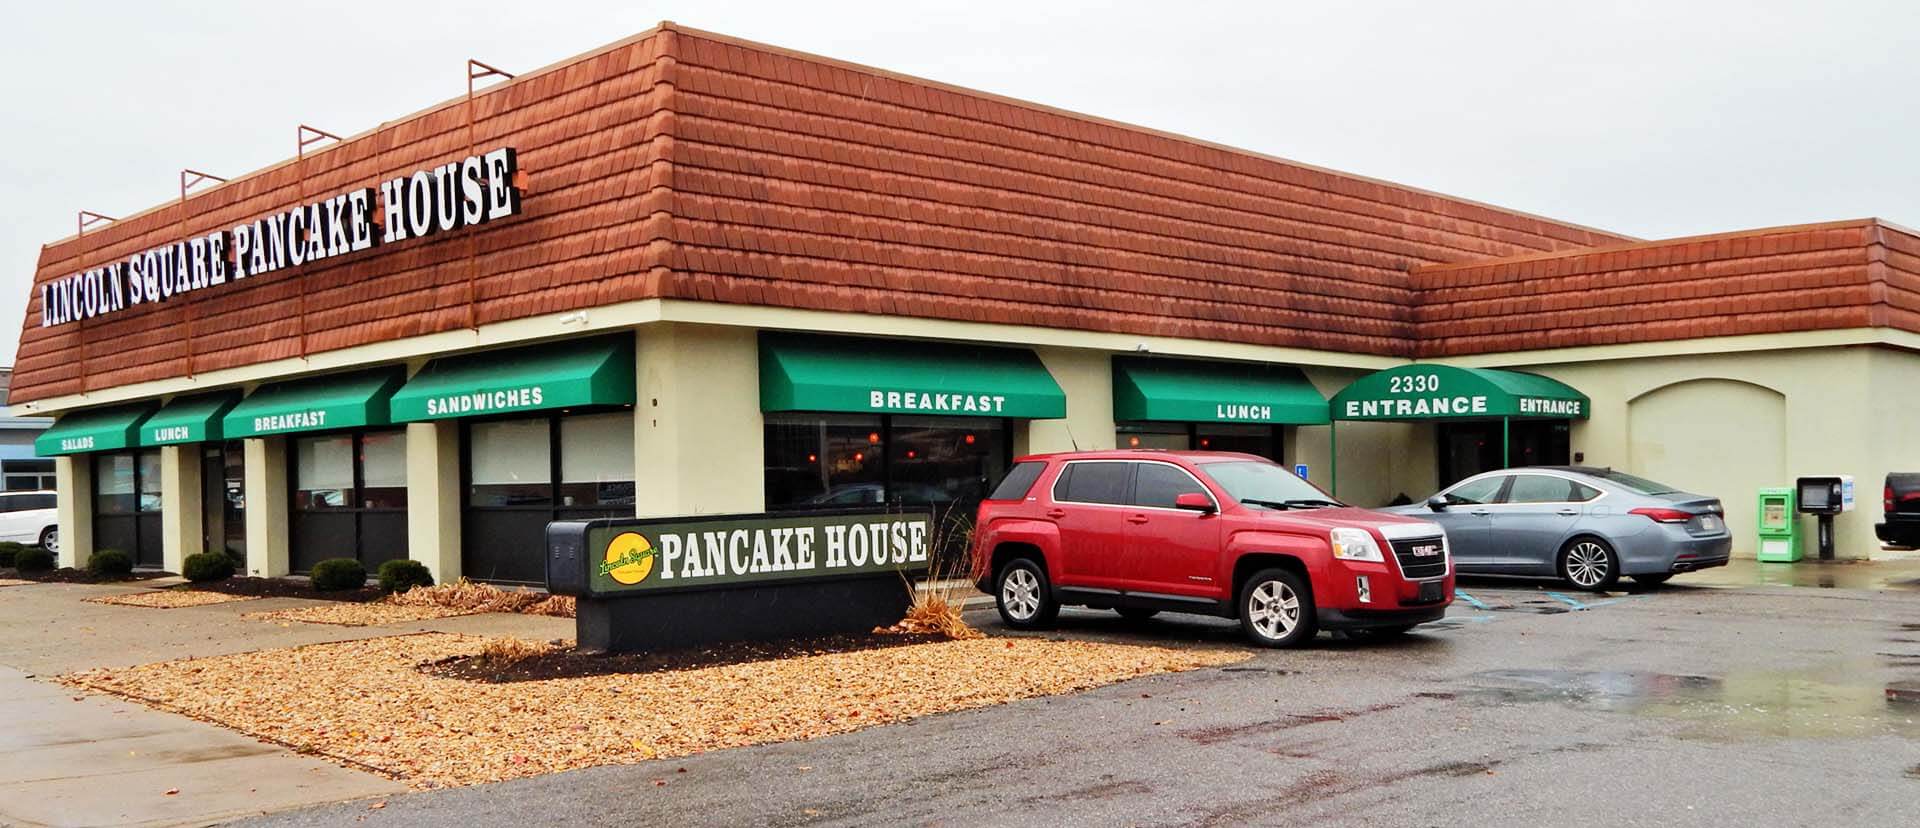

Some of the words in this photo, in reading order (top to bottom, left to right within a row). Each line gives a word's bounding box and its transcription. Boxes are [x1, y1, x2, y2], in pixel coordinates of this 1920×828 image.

[41, 261, 125, 328] LINCOLN
[127, 231, 228, 305] SQUARE
[233, 187, 373, 280] PANCAKE
[380, 147, 515, 242] HOUSE
[1390, 374, 1440, 393] 2330
[427, 386, 543, 415] SANDWICHES
[870, 390, 1005, 413] BREAKFAST
[1346, 396, 1488, 417] ENTRANCE
[1520, 398, 1581, 415] ENTRANCE
[254, 410, 326, 433] BREAKFAST
[1217, 404, 1271, 419] LUNCH
[61, 436, 94, 451] SALADS
[154, 426, 189, 442] LUNCH
[660, 527, 815, 579] PANCAKE
[825, 521, 927, 567] HOUSE
